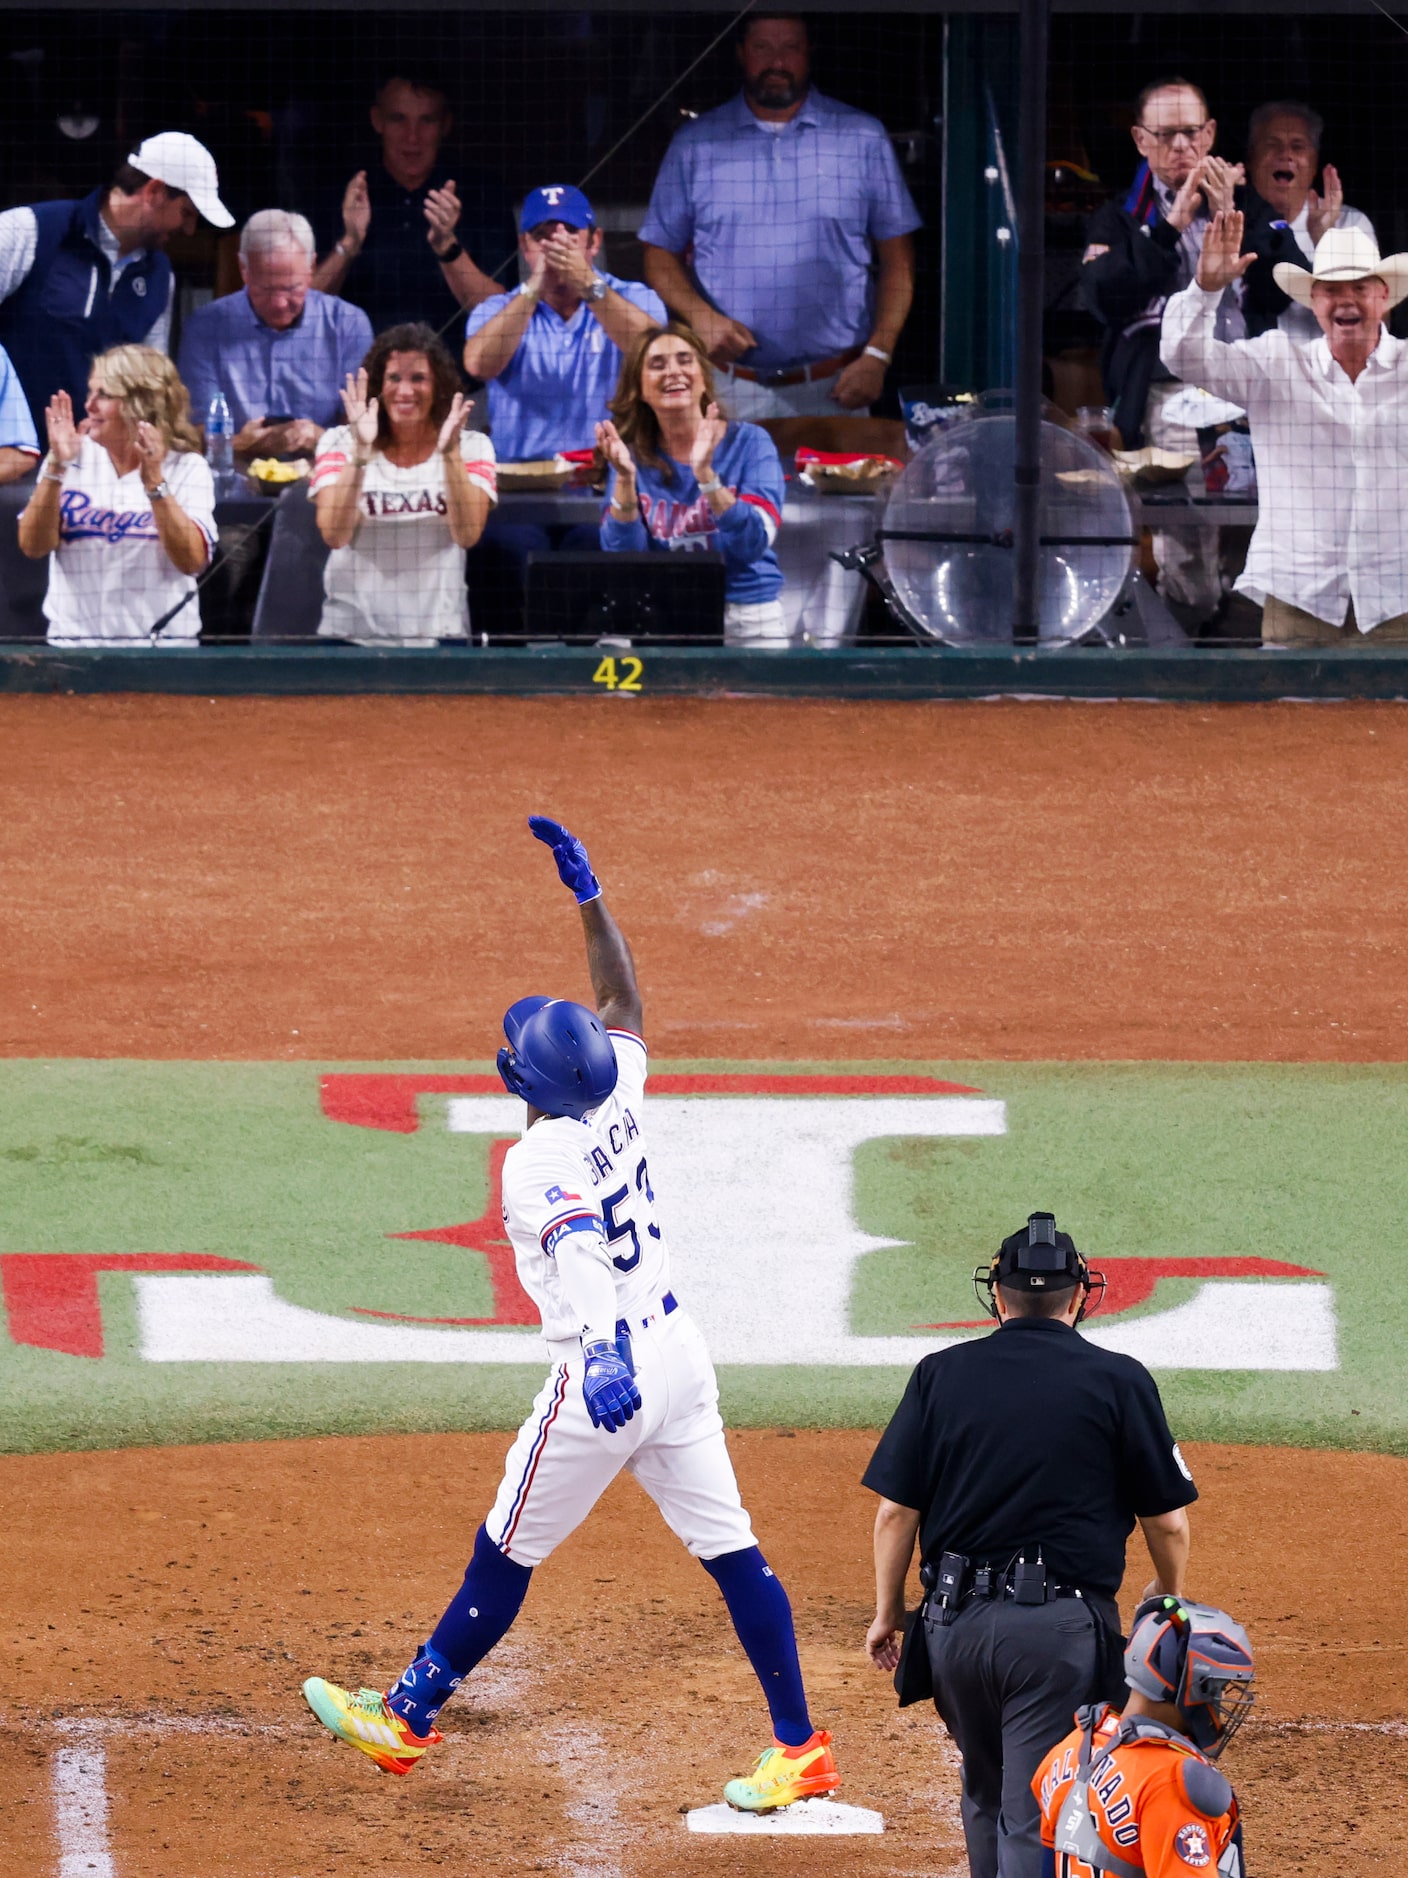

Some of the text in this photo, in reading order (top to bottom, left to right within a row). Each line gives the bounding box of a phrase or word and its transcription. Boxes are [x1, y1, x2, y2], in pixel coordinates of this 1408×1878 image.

[540, 187, 565, 206] T
[361, 489, 448, 516] TEXAS
[60, 489, 159, 544] Range
[592, 656, 644, 690] 42
[426, 1662, 441, 1679] T
[402, 1698, 417, 1714] T
[1040, 1746, 1140, 1848] MALNADO
